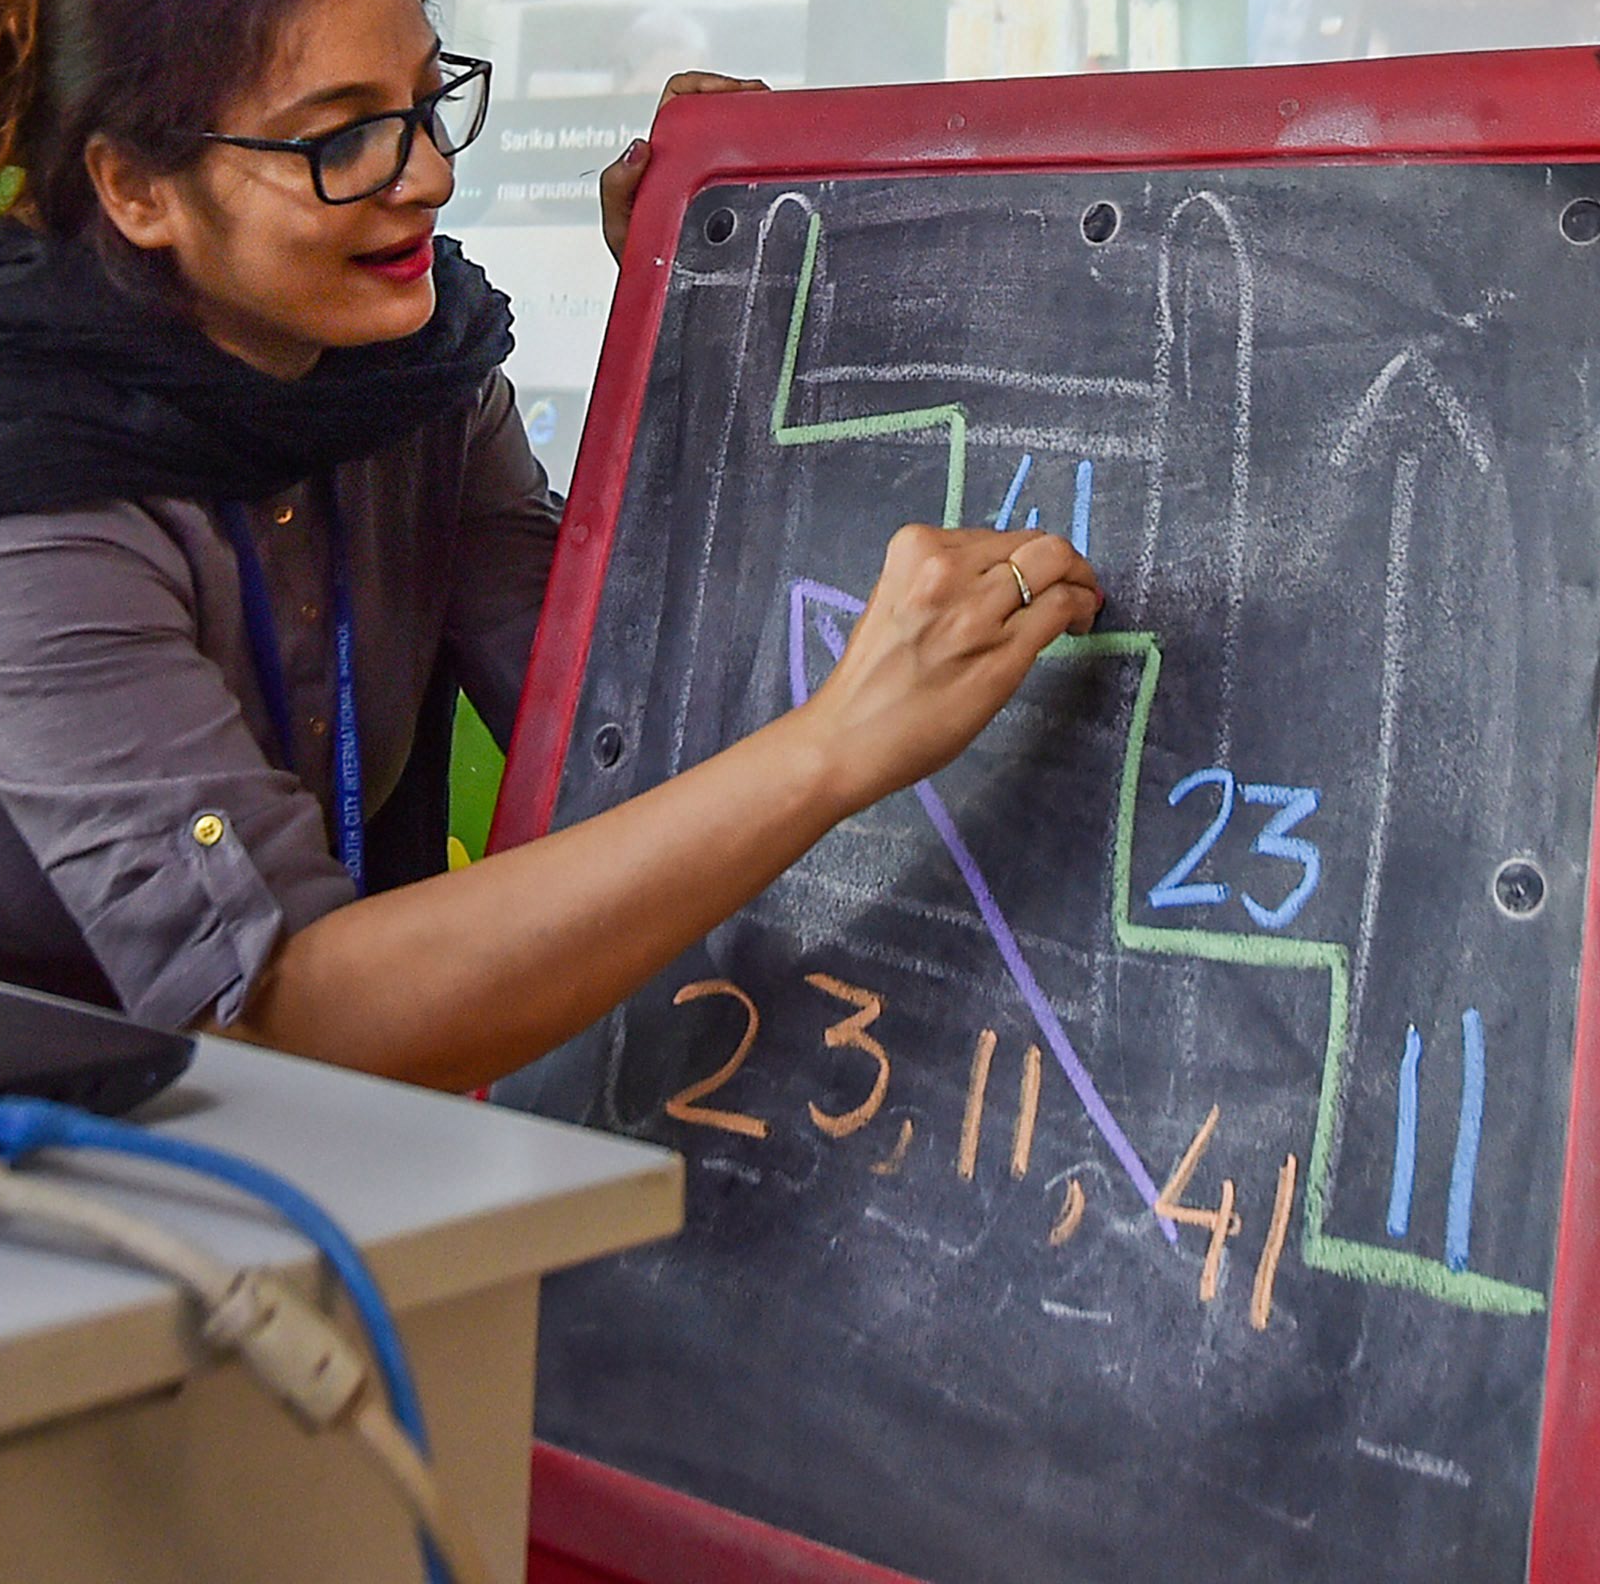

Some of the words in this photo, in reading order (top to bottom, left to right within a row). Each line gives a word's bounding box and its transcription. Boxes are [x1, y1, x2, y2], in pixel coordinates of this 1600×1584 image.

[500, 127, 555, 153] Sarika
[558, 123, 617, 150] Mehra
[339, 683, 361, 793] INTERNATIONAL
[343, 795, 361, 827] CITY
[344, 827, 362, 879] SOUTH
[1147, 768, 1322, 929] 23
[1384, 1006, 1486, 1274] 11
[1152, 1103, 1298, 1332] 41
